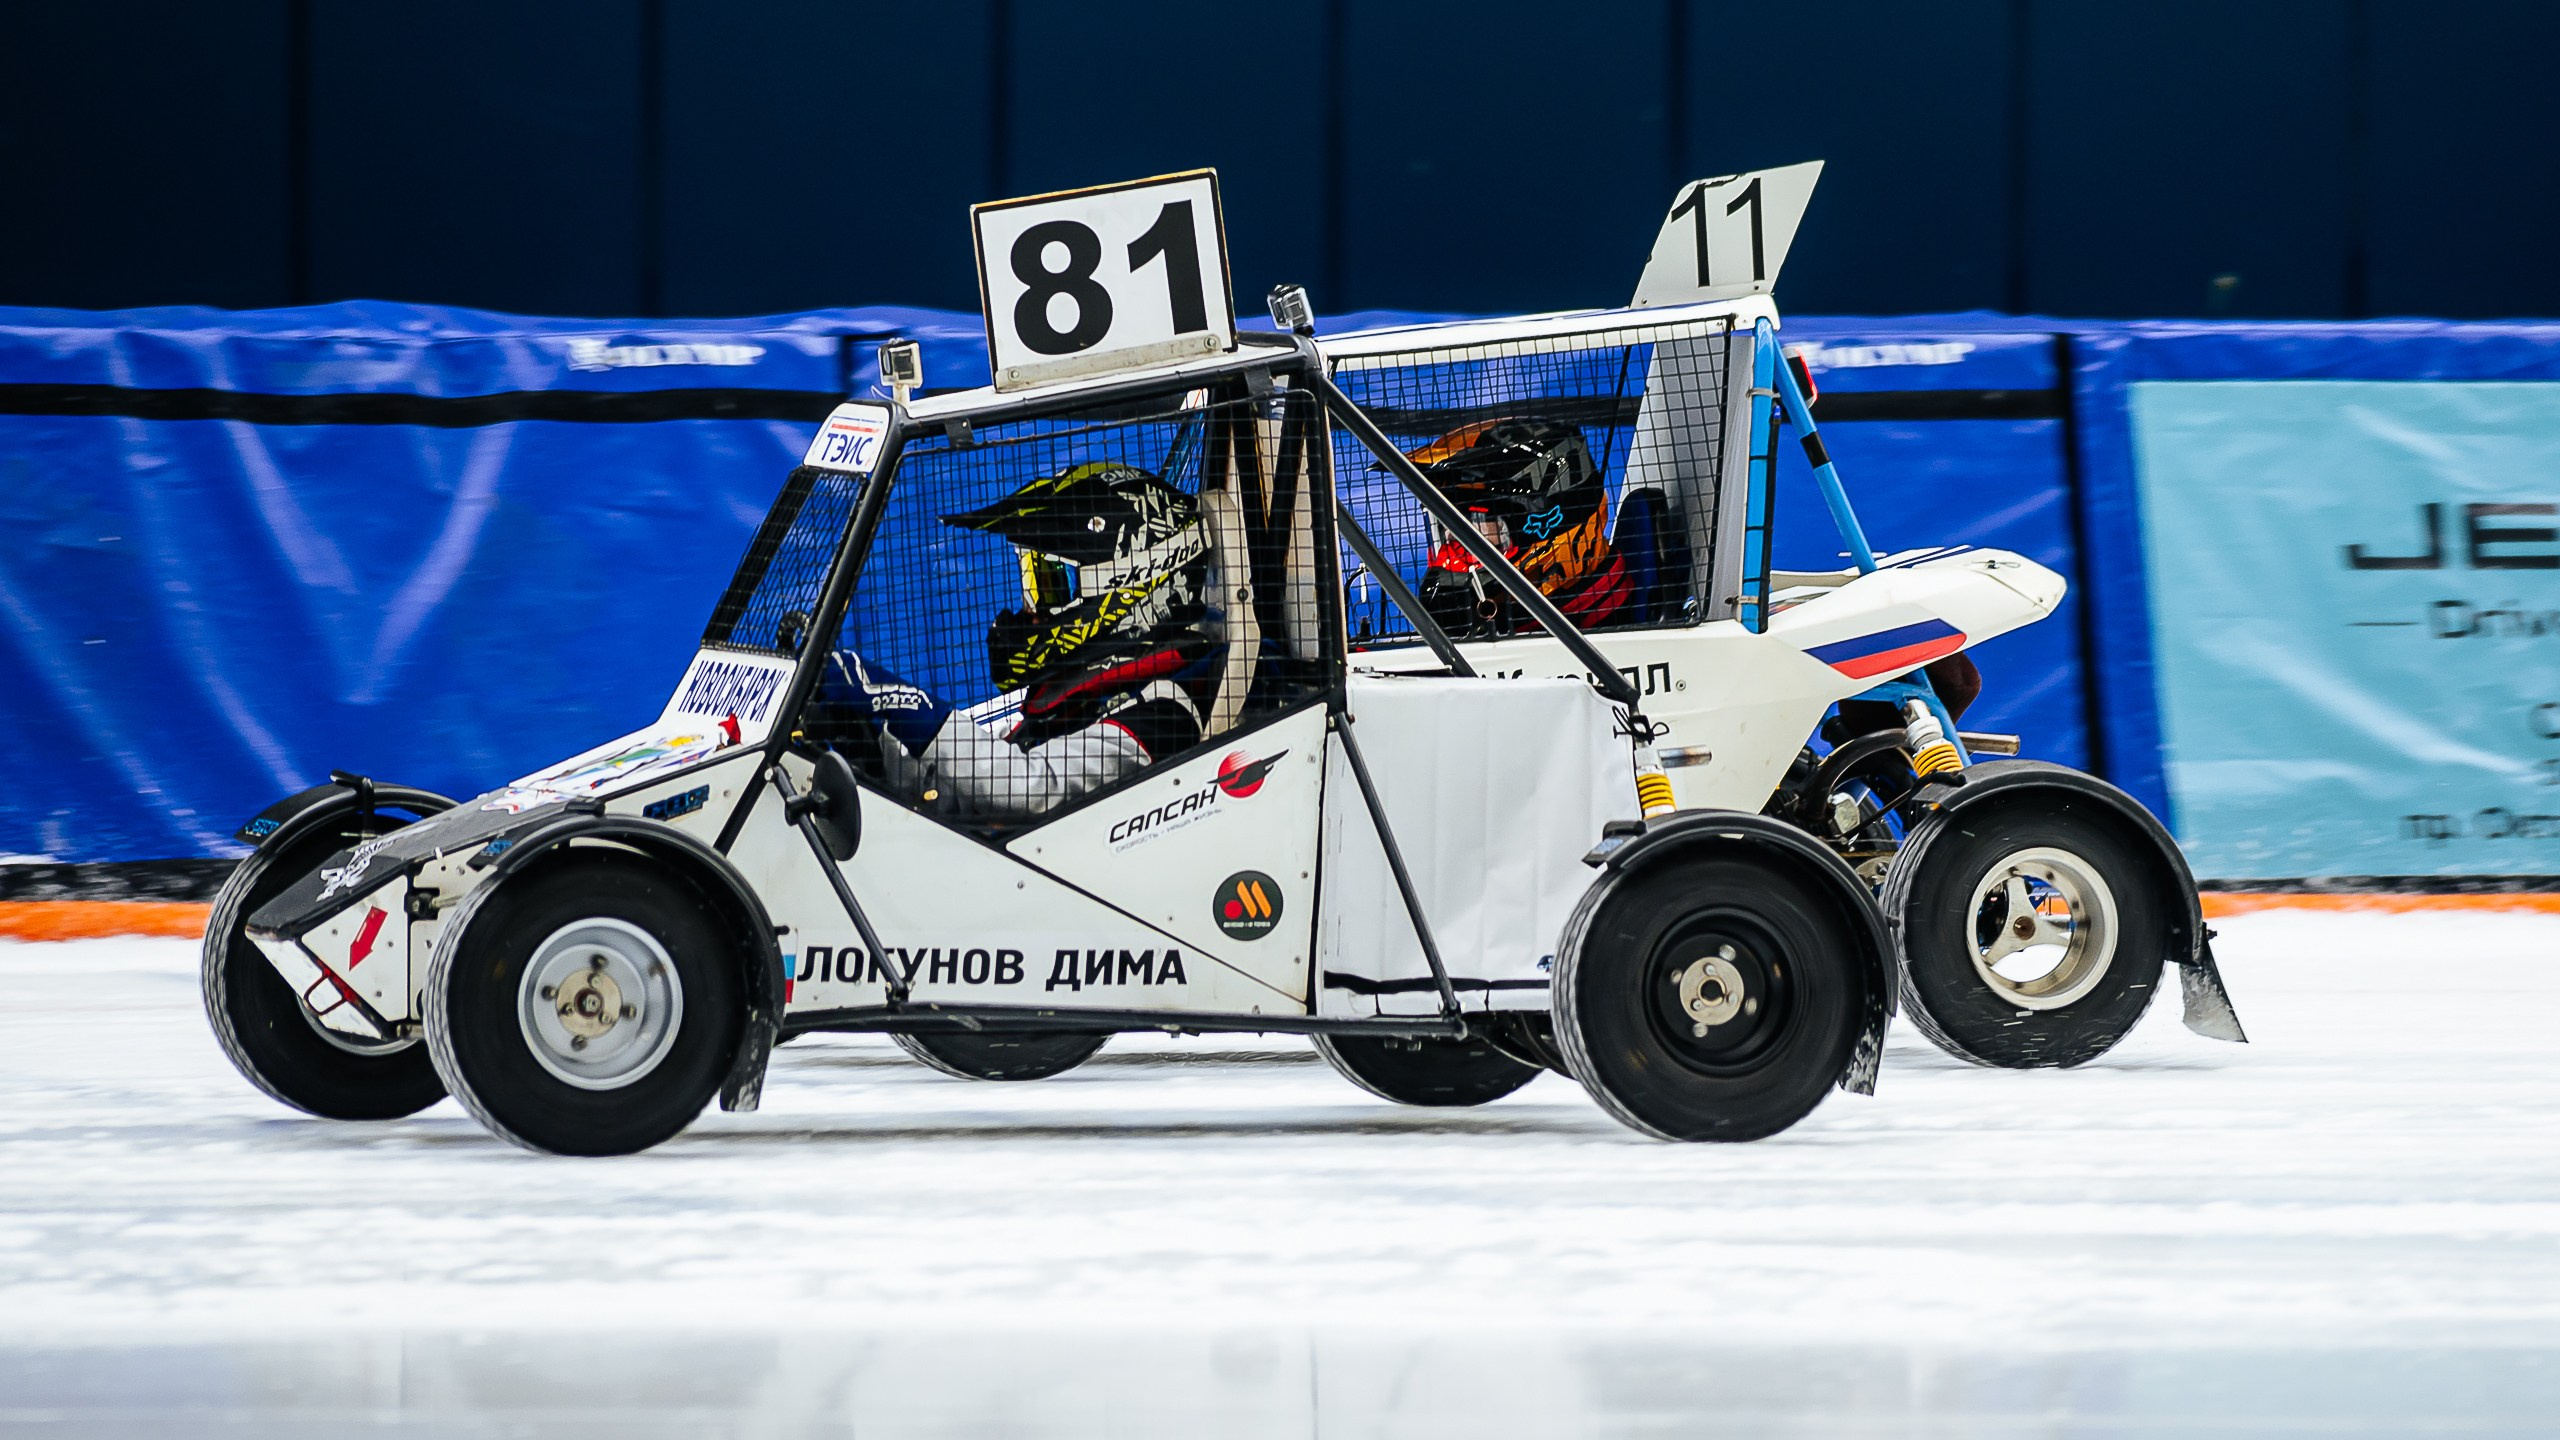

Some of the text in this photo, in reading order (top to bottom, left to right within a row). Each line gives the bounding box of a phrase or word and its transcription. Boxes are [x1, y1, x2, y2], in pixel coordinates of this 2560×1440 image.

[1671, 177, 1765, 288] 11
[1010, 199, 1208, 356] 81
[821, 432, 873, 465] ТЭИС
[678, 660, 786, 722] НОВОСИБИРСК
[1109, 785, 1217, 843] САПСАН
[1045, 949, 1188, 992] ДИМА
